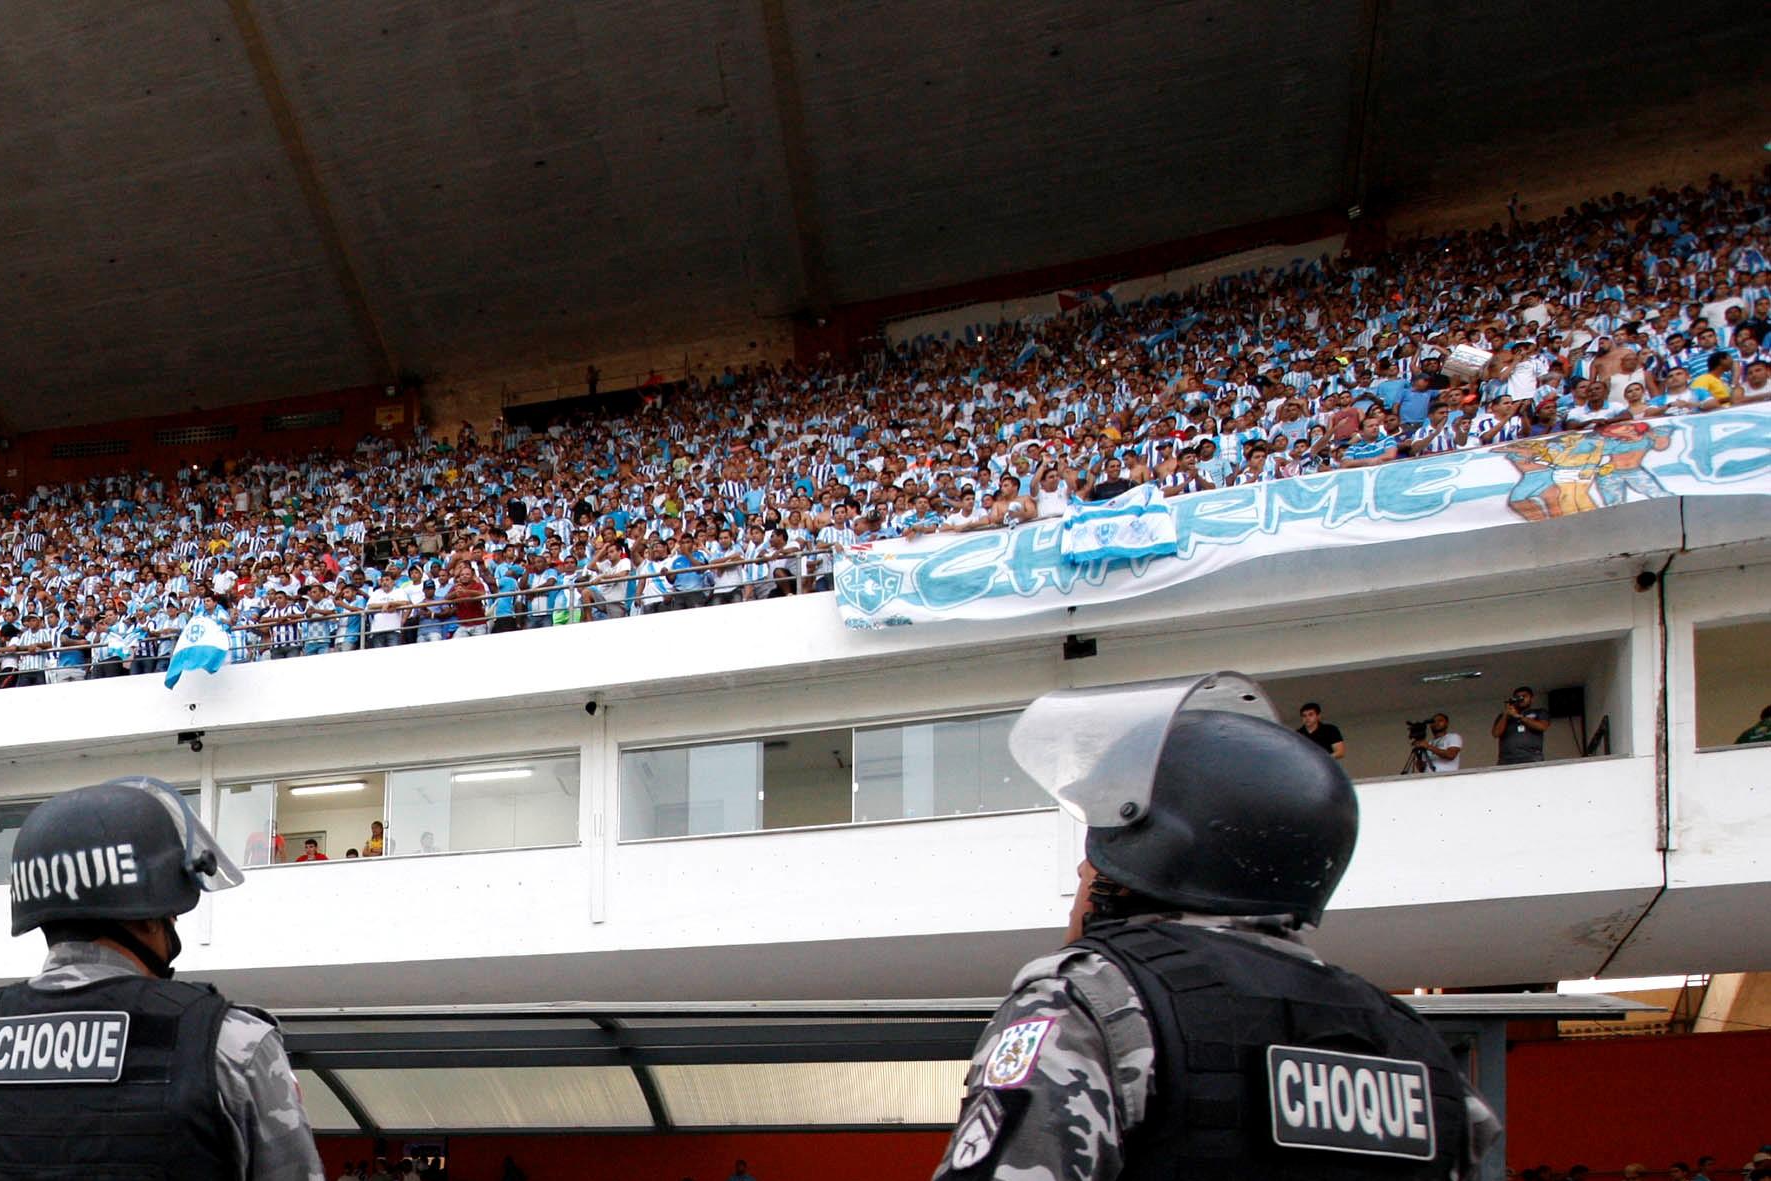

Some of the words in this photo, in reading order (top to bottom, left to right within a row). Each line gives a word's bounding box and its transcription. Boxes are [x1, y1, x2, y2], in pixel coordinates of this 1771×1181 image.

[915, 453, 1465, 611] CHRME
[11, 843, 138, 902] HOQUE
[1279, 1059, 1427, 1140] CHOQUE
